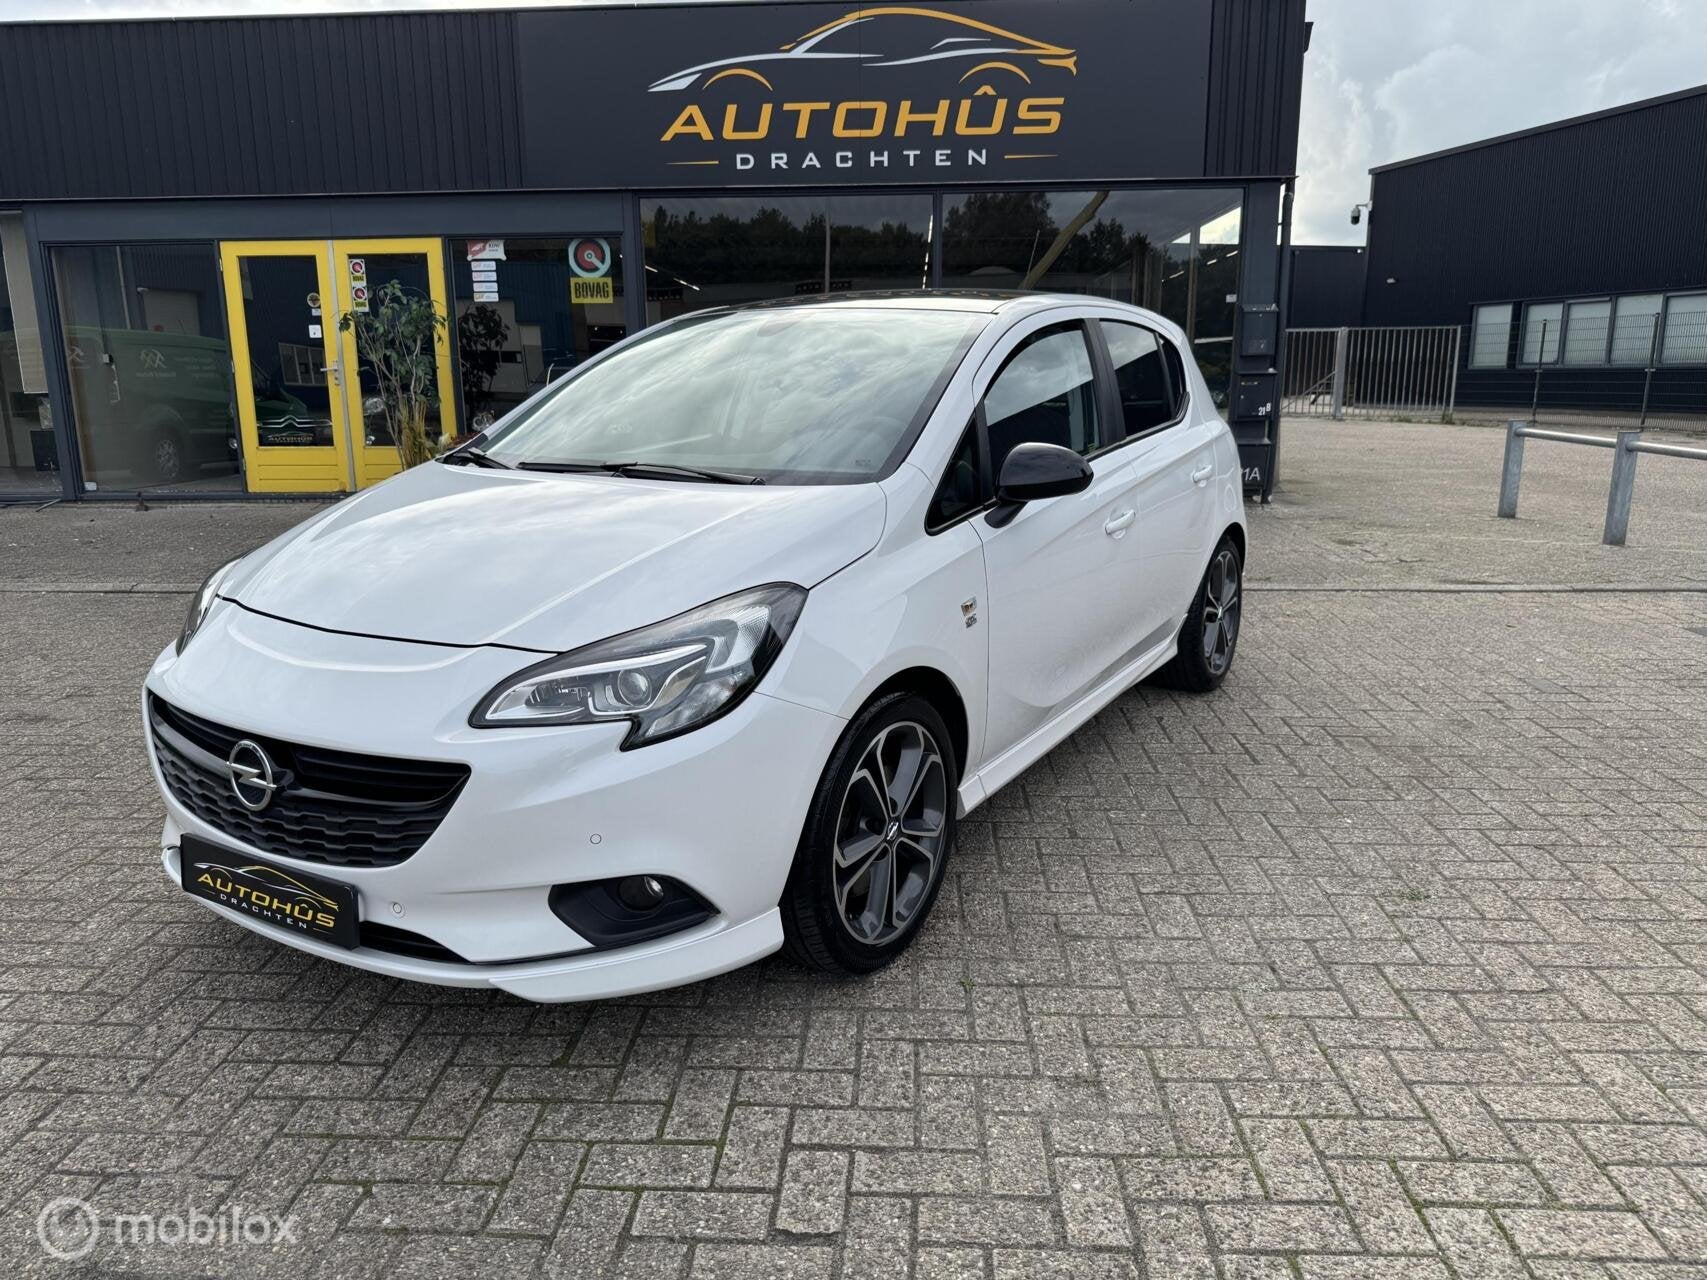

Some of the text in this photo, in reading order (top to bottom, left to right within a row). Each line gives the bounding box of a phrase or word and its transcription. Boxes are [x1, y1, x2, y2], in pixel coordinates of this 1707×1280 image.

[660, 85, 1065, 142] AUTOHÛS
[735, 148, 987, 170] DRACHTEN
[574, 281, 610, 299] BOVAG
[1240, 466, 1261, 481] 1A
[220, 893, 308, 929] DRACHTEN
